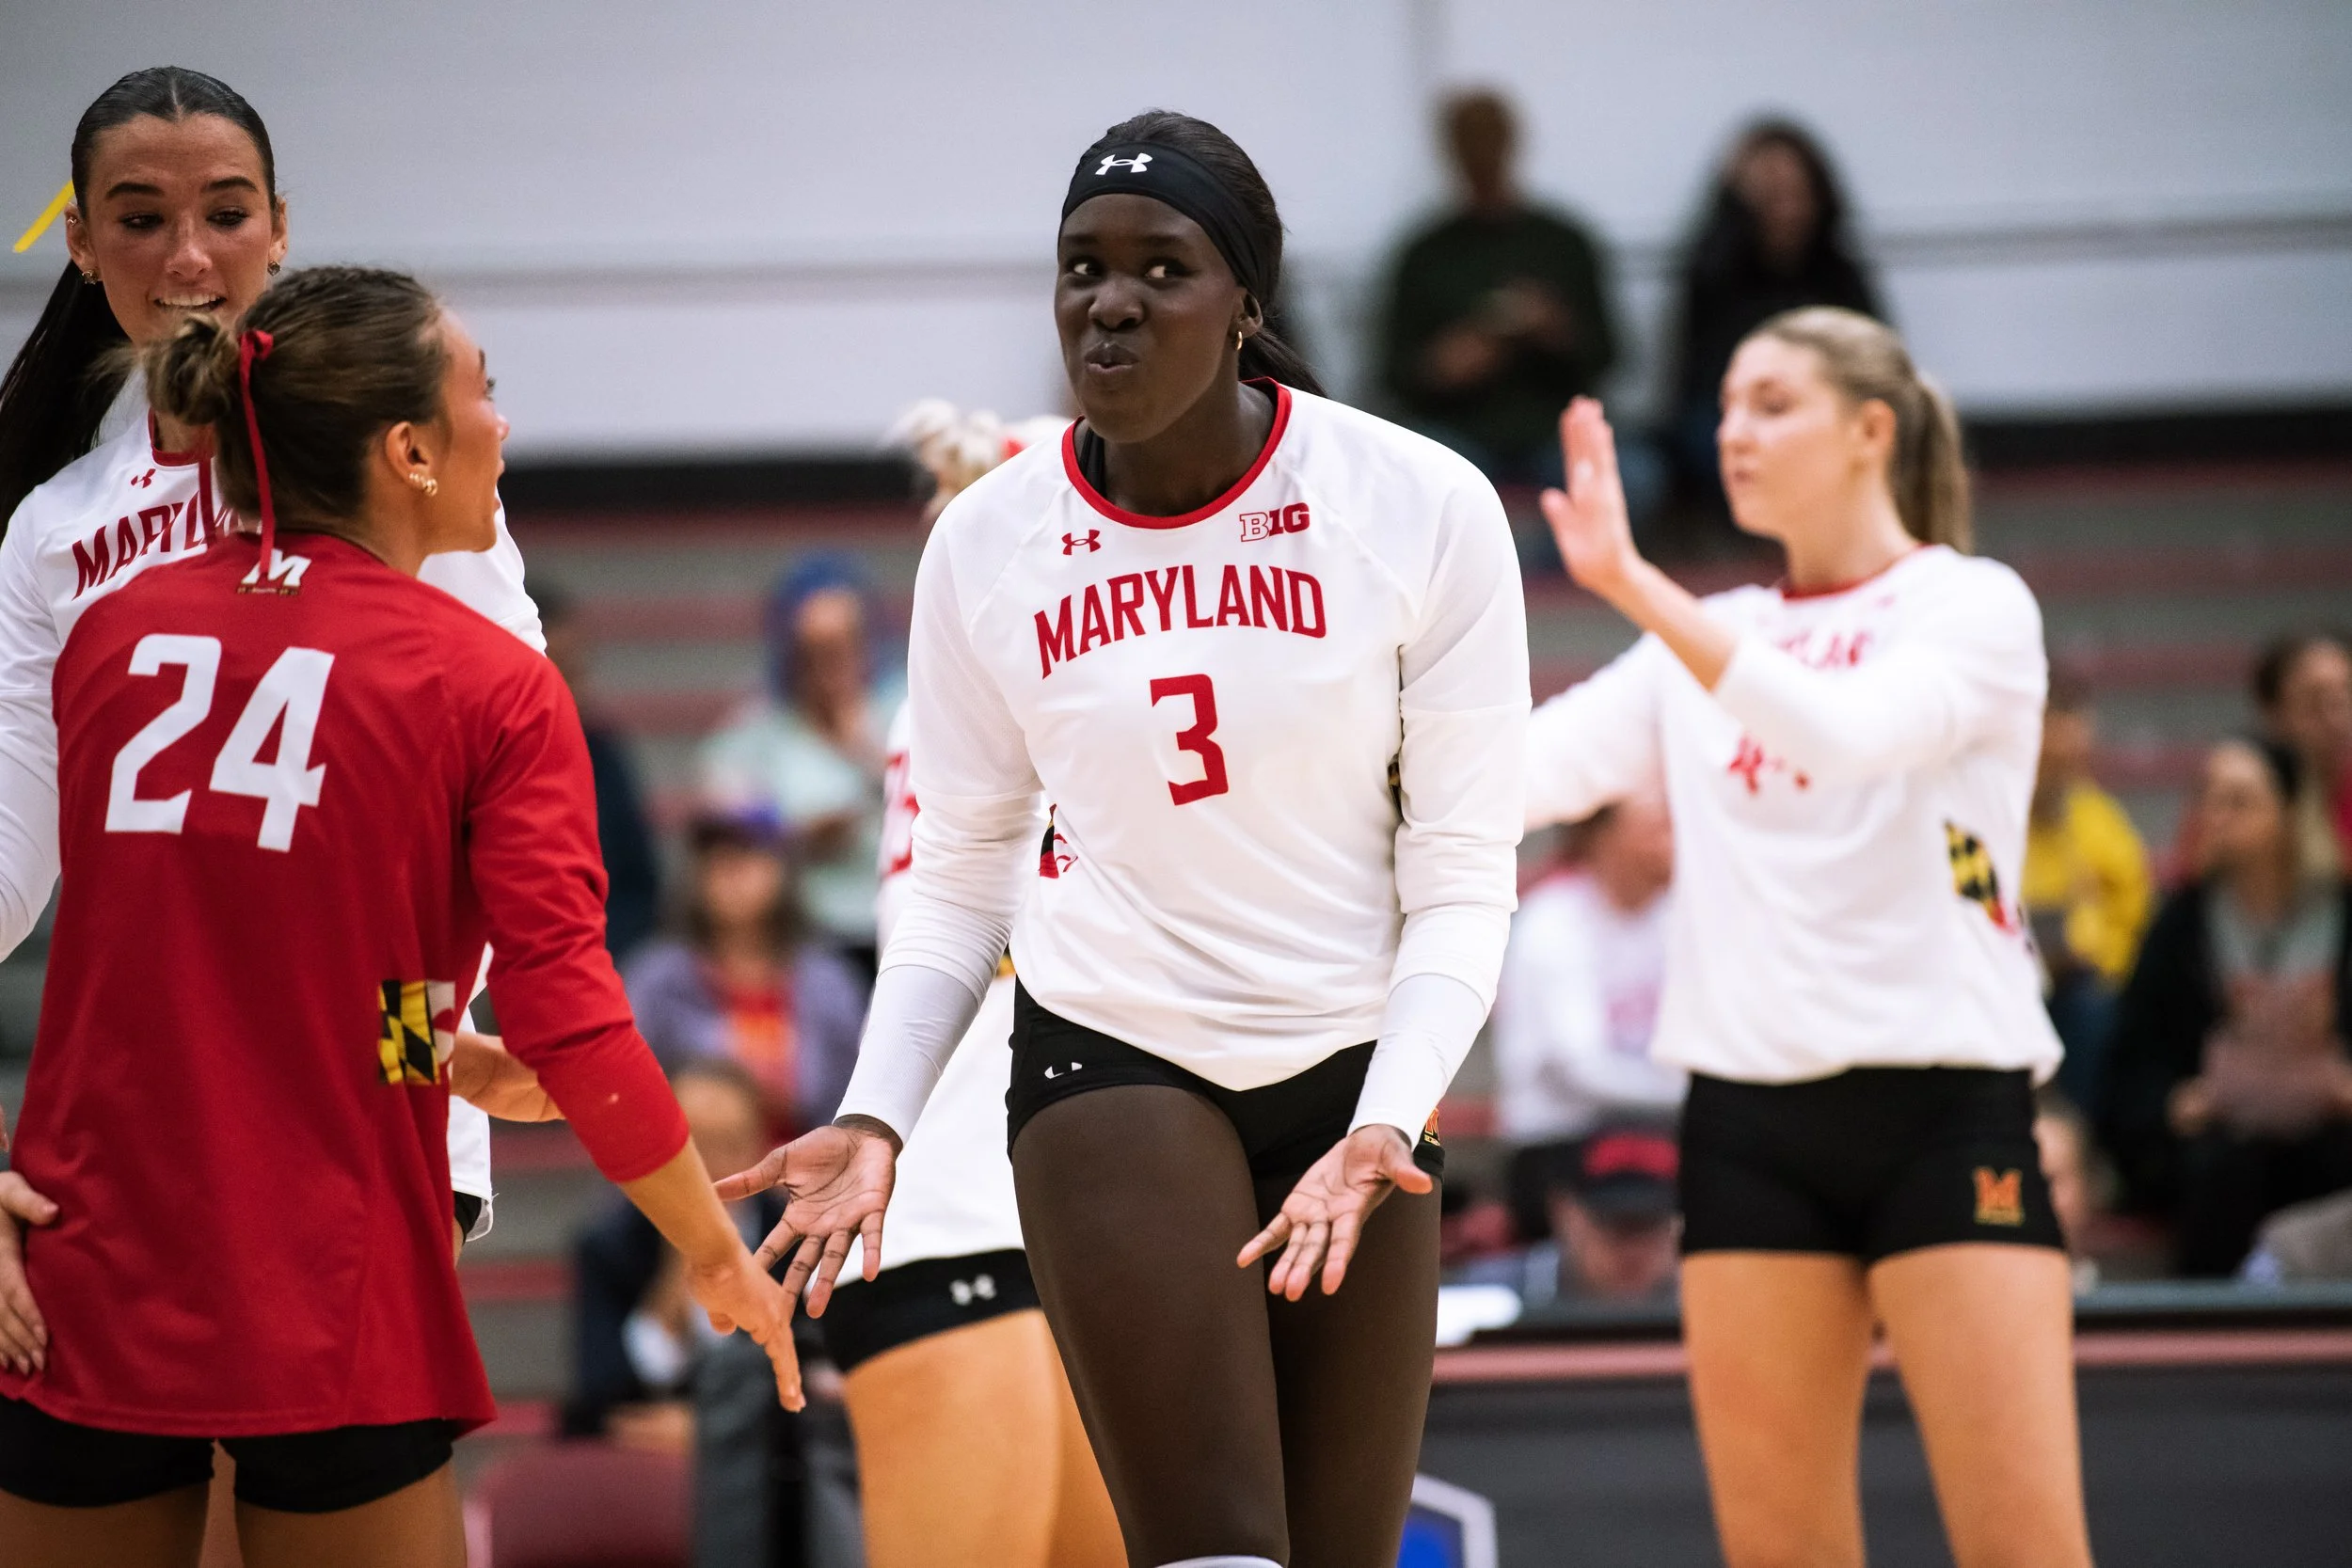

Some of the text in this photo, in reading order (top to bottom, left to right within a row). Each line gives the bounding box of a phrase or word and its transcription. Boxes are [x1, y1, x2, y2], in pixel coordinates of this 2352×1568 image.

[1034, 564, 1327, 680] MARYLAND
[104, 633, 336, 853] 24
[1149, 673, 1229, 806] 3
